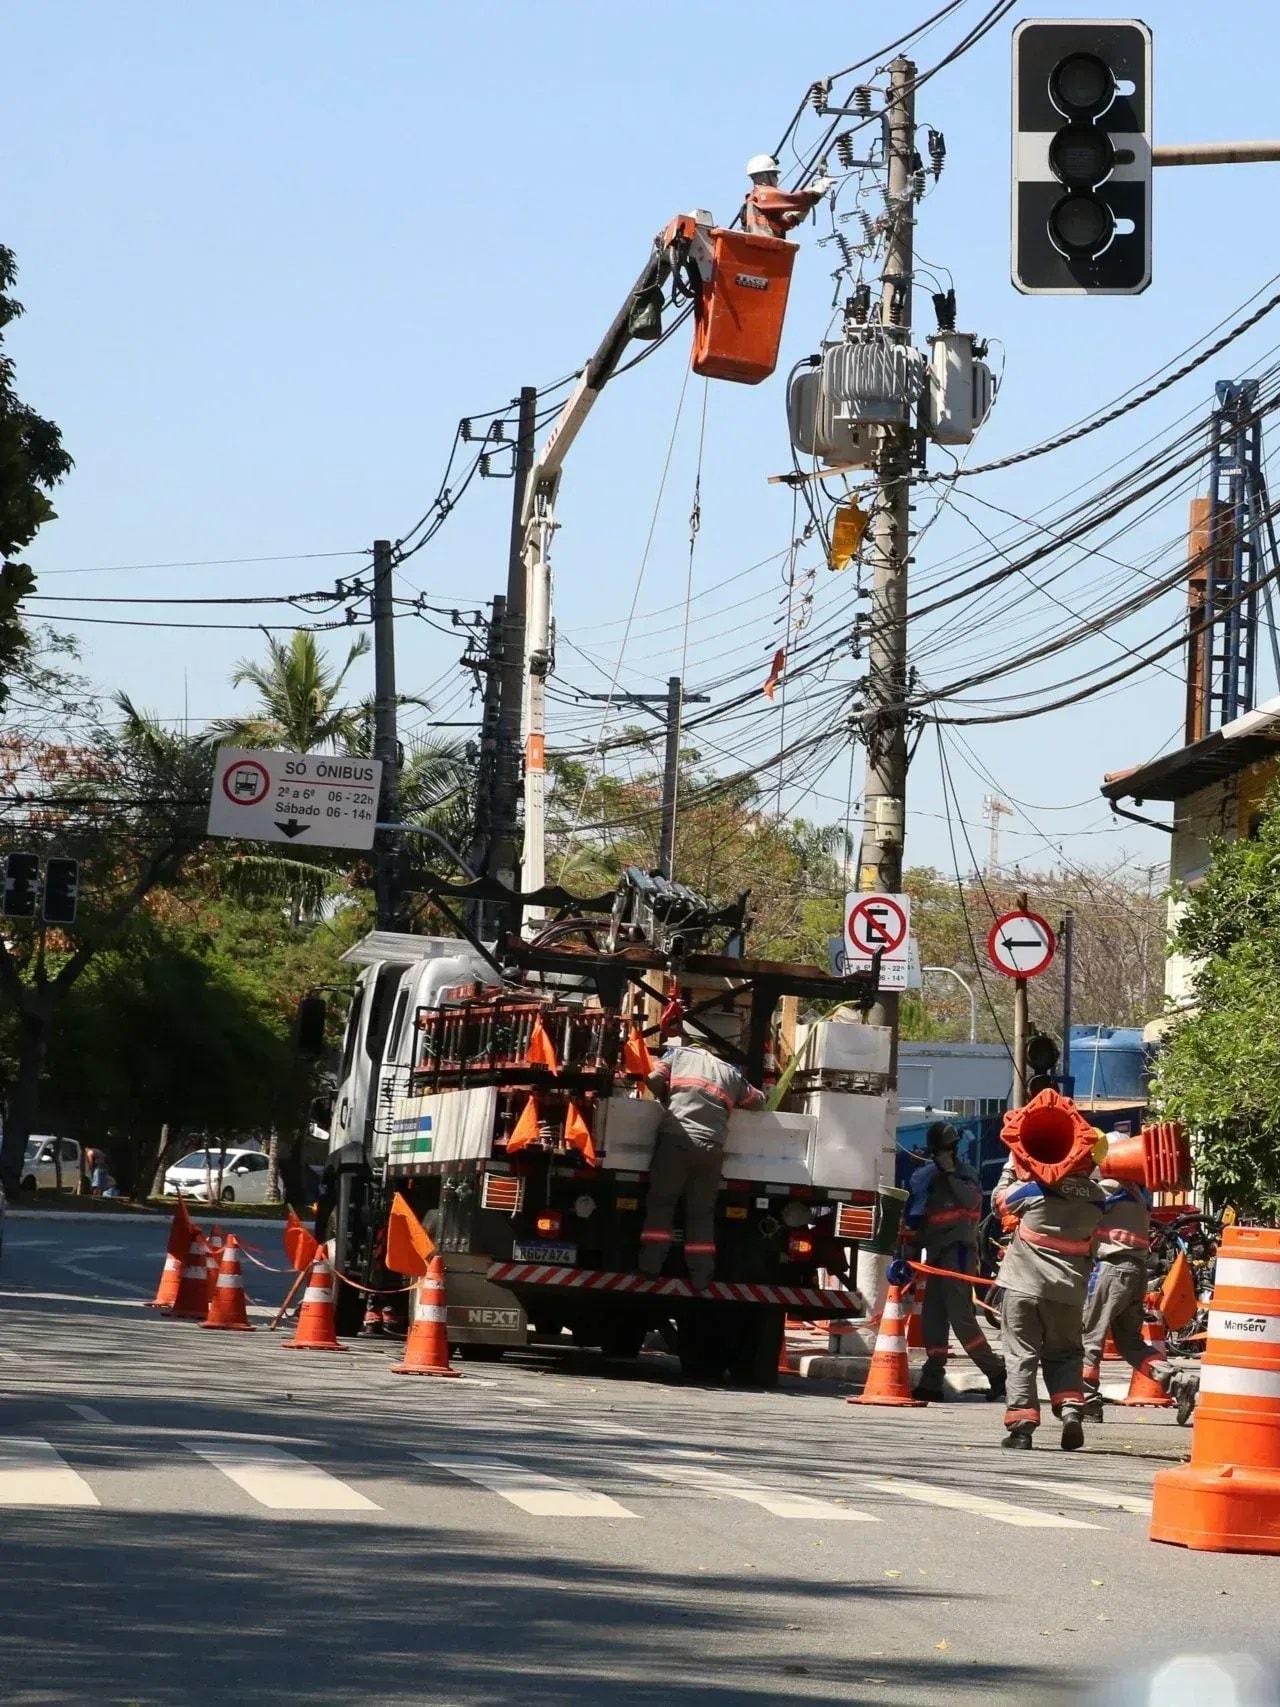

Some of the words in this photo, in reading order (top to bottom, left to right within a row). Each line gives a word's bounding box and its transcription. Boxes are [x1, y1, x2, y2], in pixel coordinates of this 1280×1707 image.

[285, 759, 307, 775] SÓ
[316, 761, 374, 781] ÔNIBUS
[292, 790, 300, 799] a
[328, 791, 342, 802] 06
[353, 793, 374, 805] 22h
[275, 801, 320, 816] Sábado
[326, 806, 341, 817] 06
[352, 808, 372, 820] 14h
[866, 909, 889, 943] E
[1061, 1184, 1090, 1198] enel
[468, 1309, 517, 1324] NEXT
[1224, 1319, 1266, 1332] Manserv
